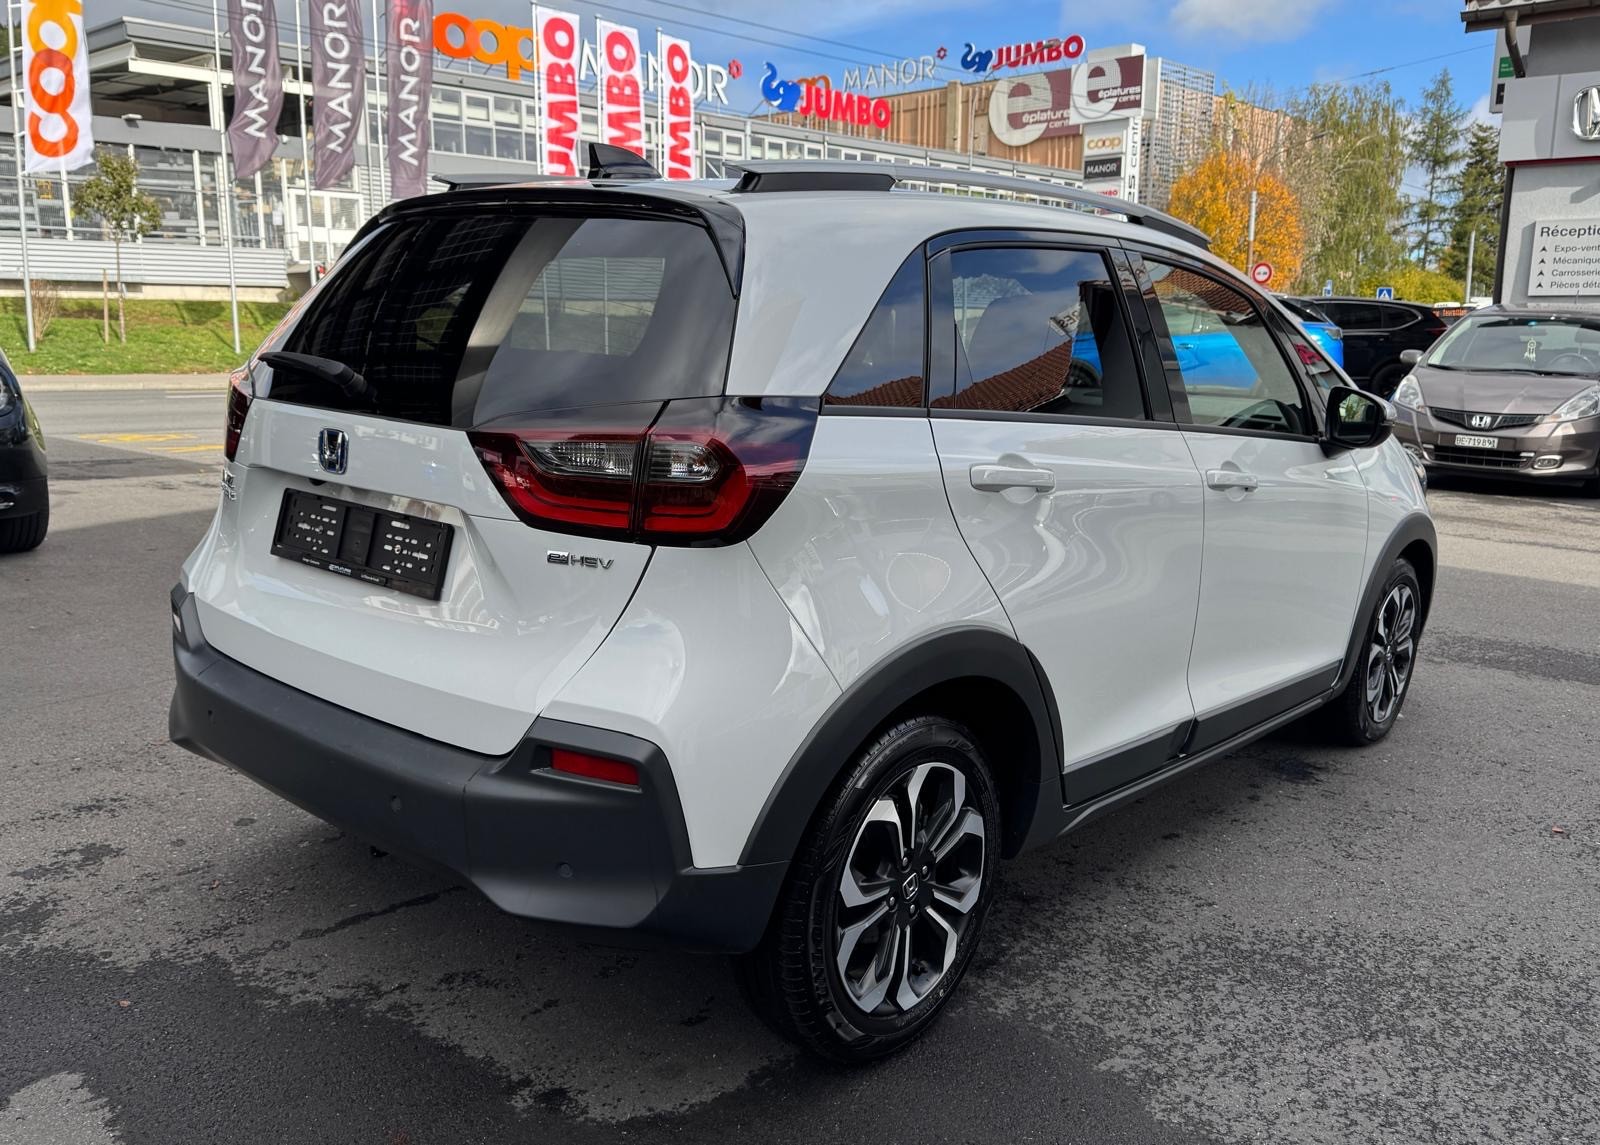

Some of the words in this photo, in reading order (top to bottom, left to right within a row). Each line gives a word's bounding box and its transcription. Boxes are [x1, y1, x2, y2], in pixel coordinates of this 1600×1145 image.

[432, 12, 541, 81] oop
[991, 34, 1085, 70] JUMBO
[28, 0, 79, 158] coo
[322, 2, 353, 154] MANOR
[398, 17, 421, 167] MANOR
[543, 17, 578, 177] UMBO
[606, 31, 643, 158] MBO
[843, 56, 936, 92] MANOR
[799, 82, 891, 129] JUMBO
[1022, 109, 1070, 124] éplature
[1048, 119, 1070, 129] cent
[1087, 136, 1121, 149] coop
[1131, 117, 1139, 168] centr
[1086, 162, 1117, 174] MANOR
[1550, 281, 1580, 289] Pièces
